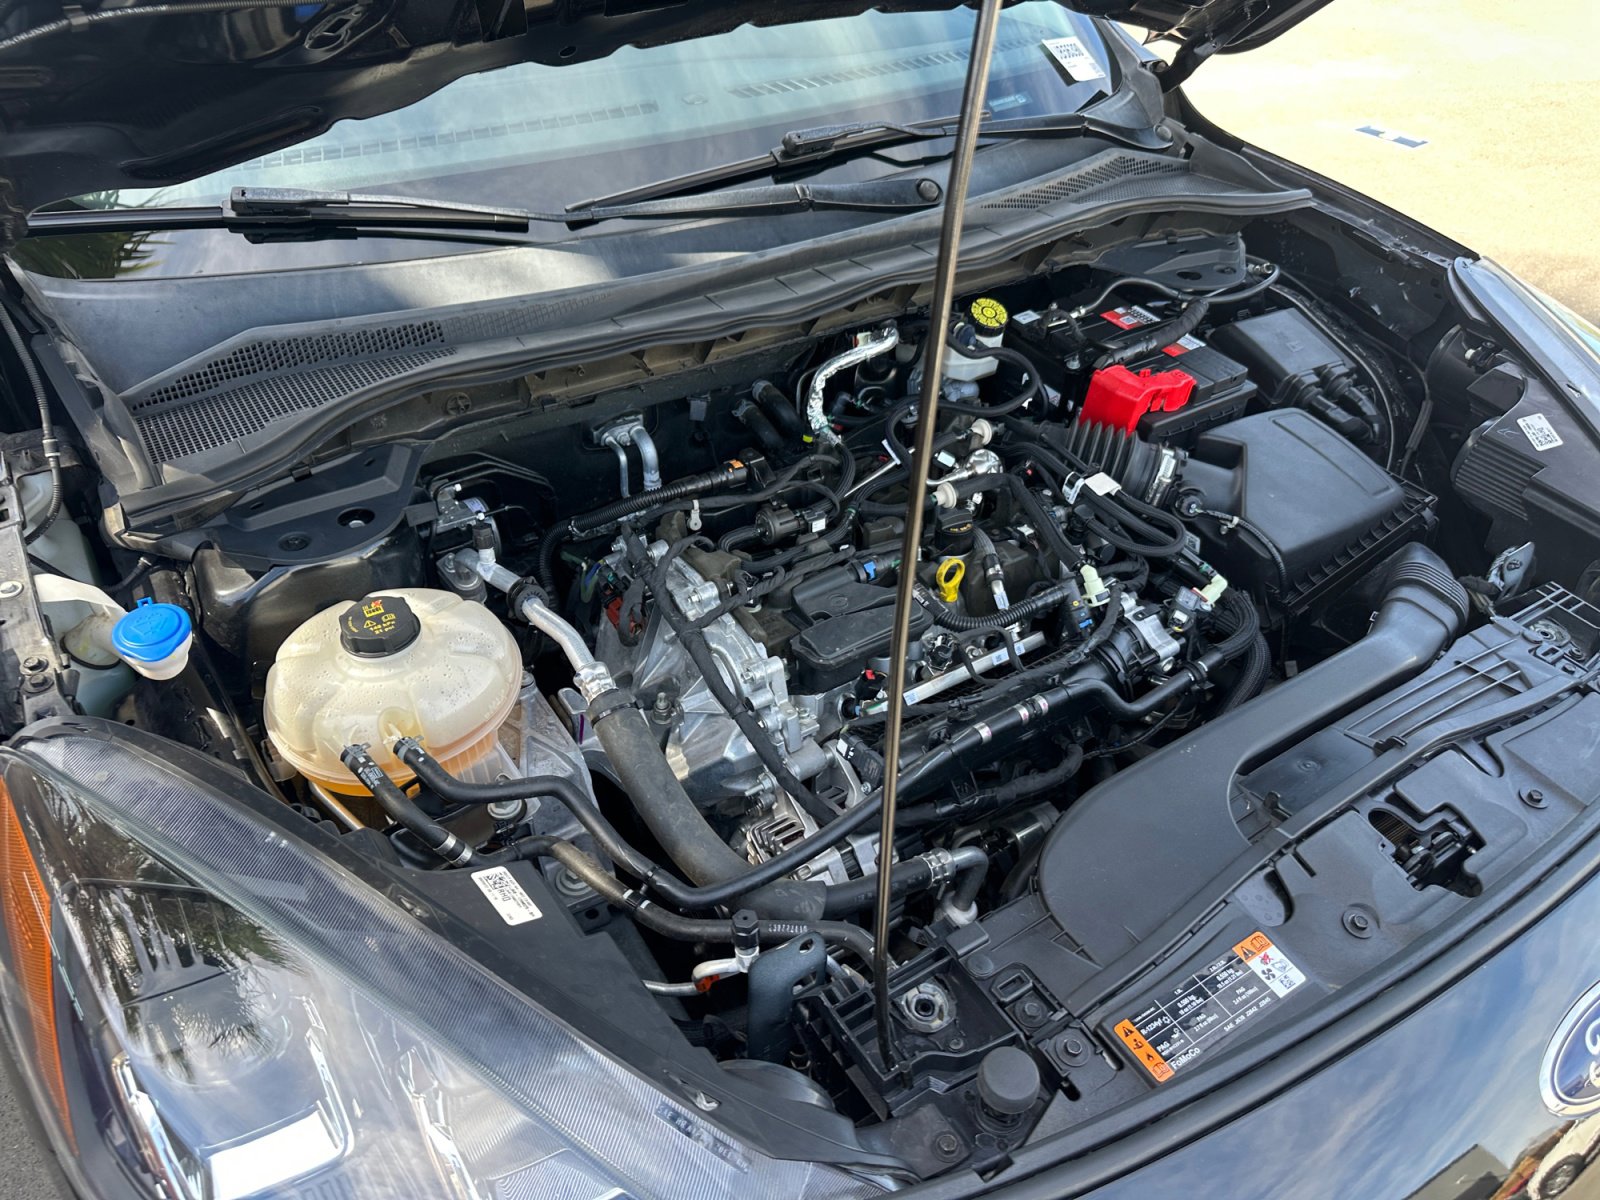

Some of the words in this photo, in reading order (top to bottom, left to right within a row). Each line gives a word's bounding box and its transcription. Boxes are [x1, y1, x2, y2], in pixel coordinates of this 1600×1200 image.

[1140, 1017, 1163, 1036] R-1234yf
[1156, 1041, 1170, 1052] PAG
[1170, 1047, 1201, 1070] FoMoCo
